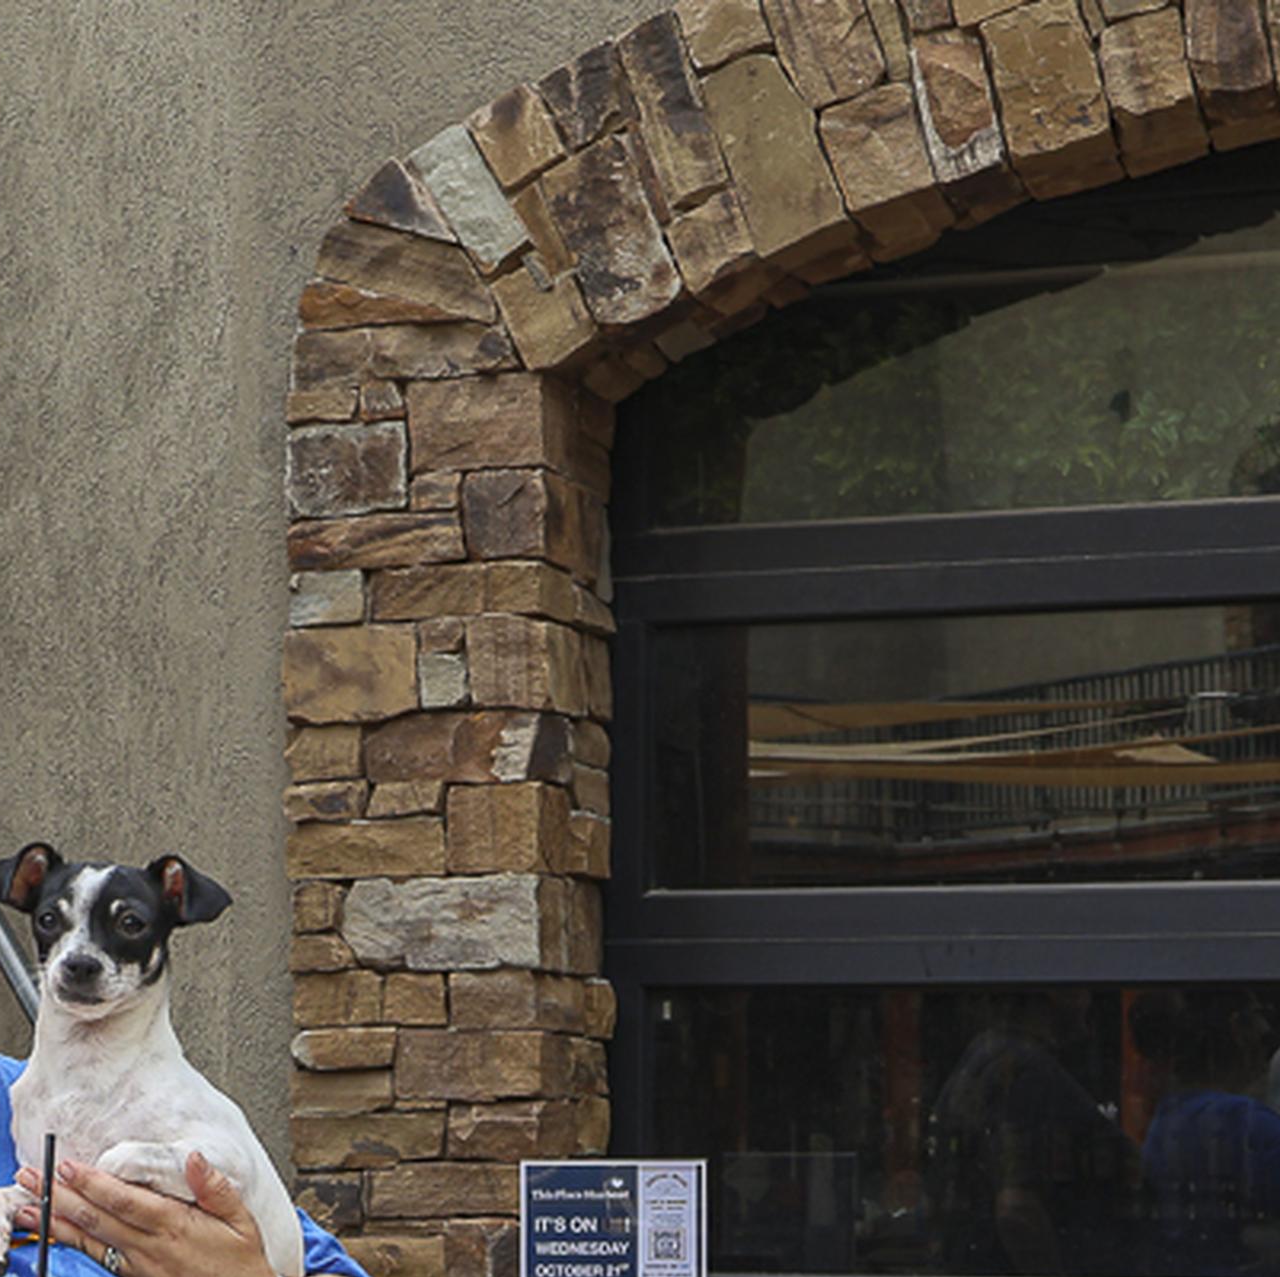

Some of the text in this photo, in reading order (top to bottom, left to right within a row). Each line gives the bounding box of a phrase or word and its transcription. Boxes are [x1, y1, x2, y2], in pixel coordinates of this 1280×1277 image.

[534, 1215, 567, 1233] IT'S
[569, 1216, 598, 1233] ON
[535, 1241, 630, 1256] WEDNESDAY
[535, 1263, 604, 1277] OCTOBER
